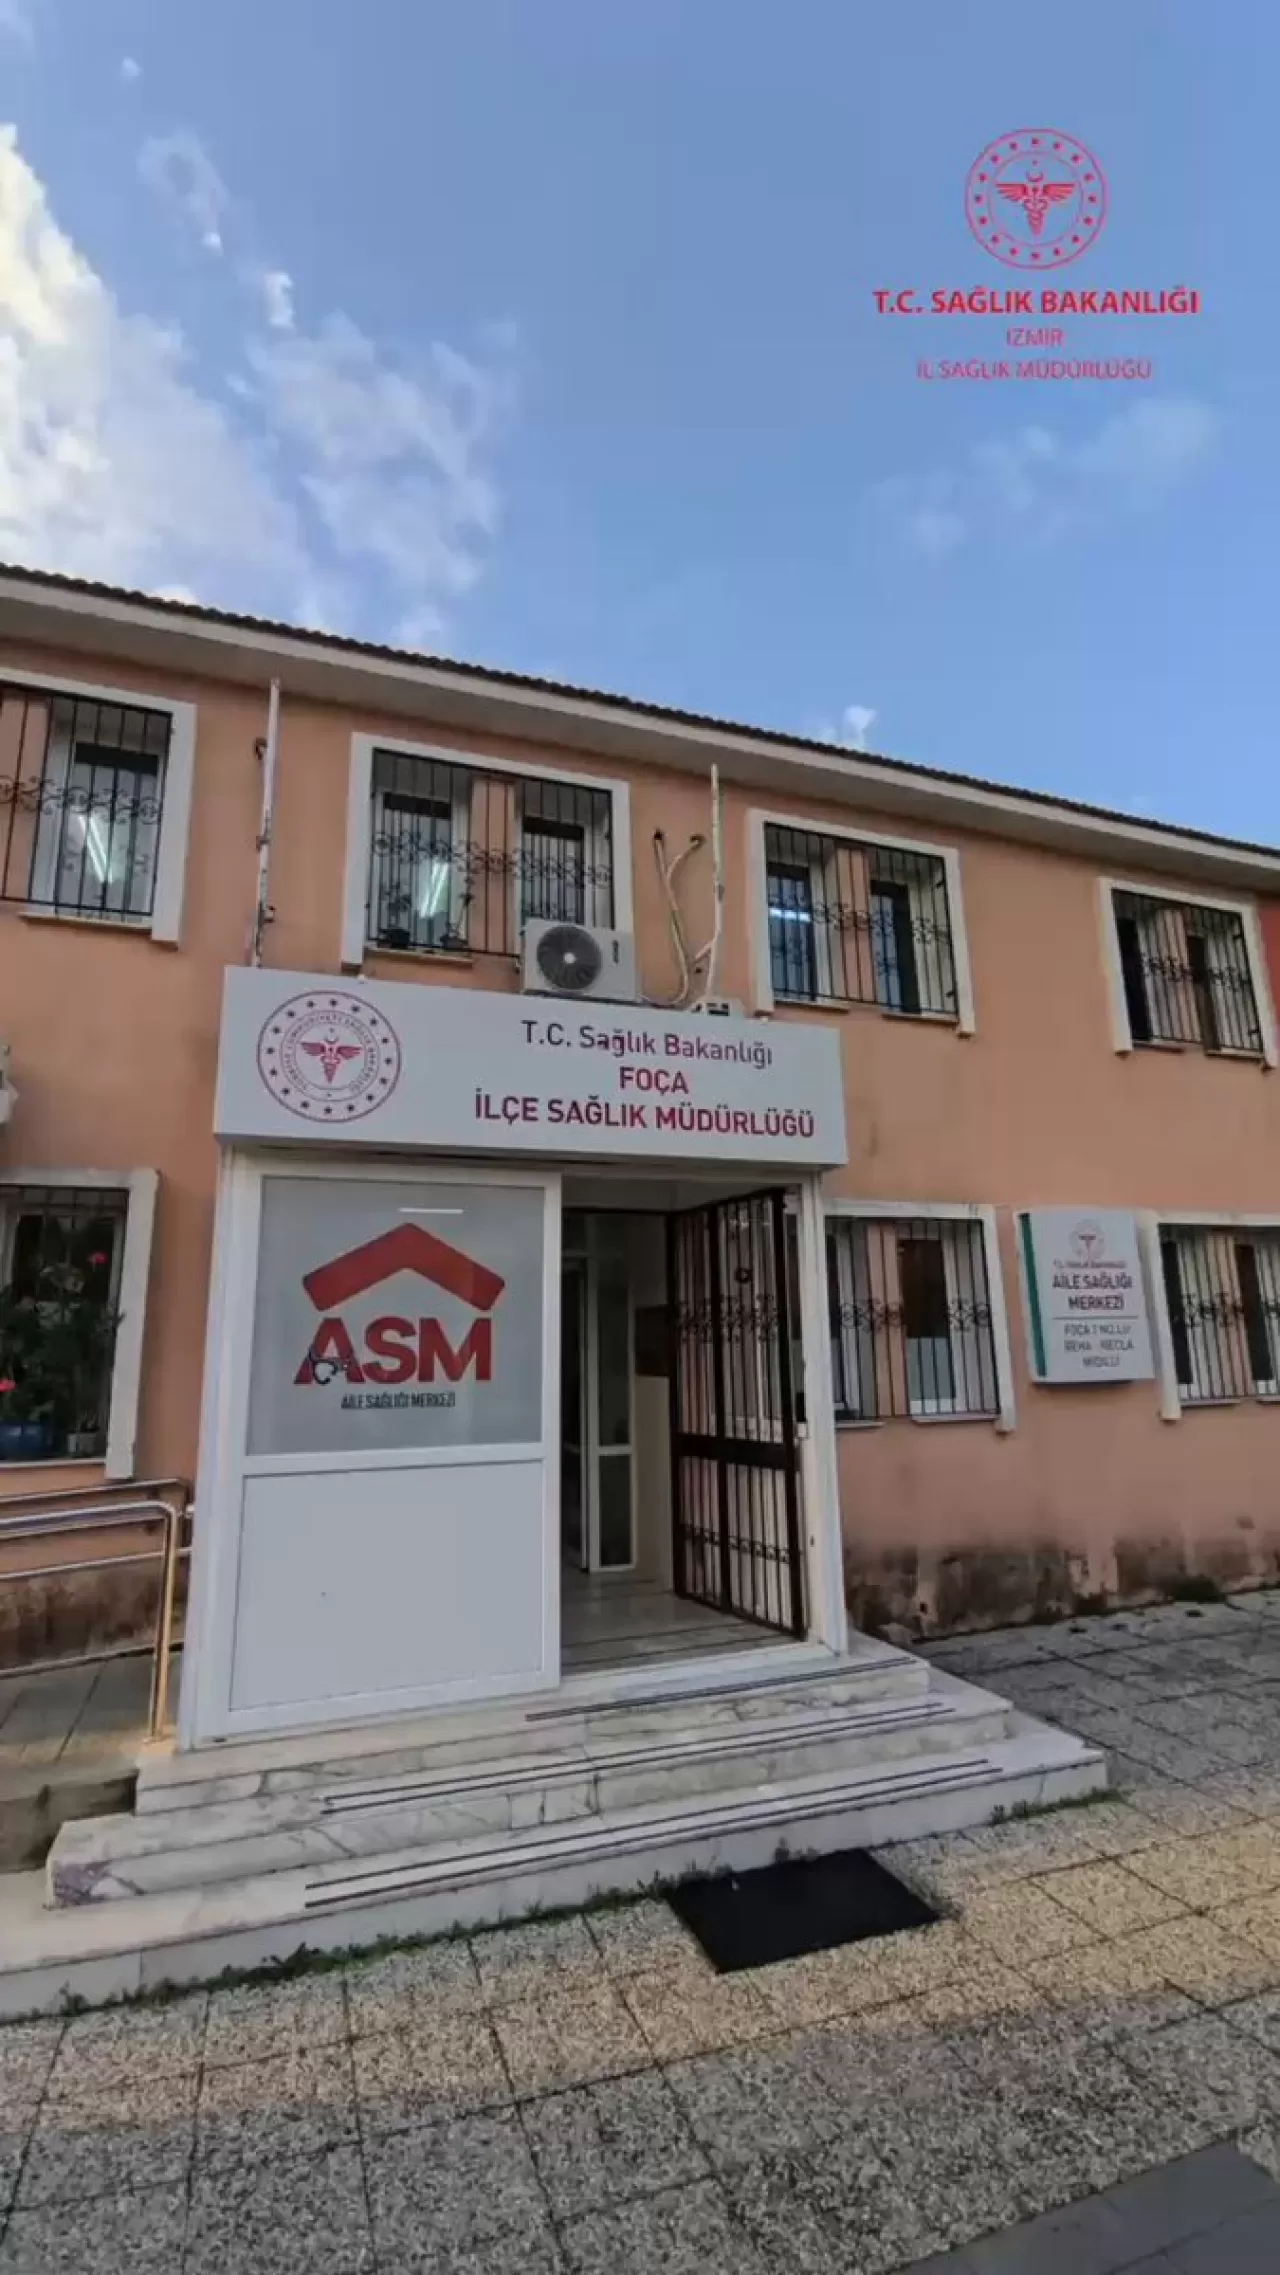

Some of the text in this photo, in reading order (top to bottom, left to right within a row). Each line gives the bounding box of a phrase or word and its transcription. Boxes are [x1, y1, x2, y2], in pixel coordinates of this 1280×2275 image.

[521, 1019, 773, 1069] T.C. Sağlık Bakanlığı
[619, 1066, 690, 1096] FOÇA
[474, 1087, 816, 1138] İLÇE SAĞLIK MÜDÜRLÜĞÜ
[293, 1316, 493, 1385] ASM
